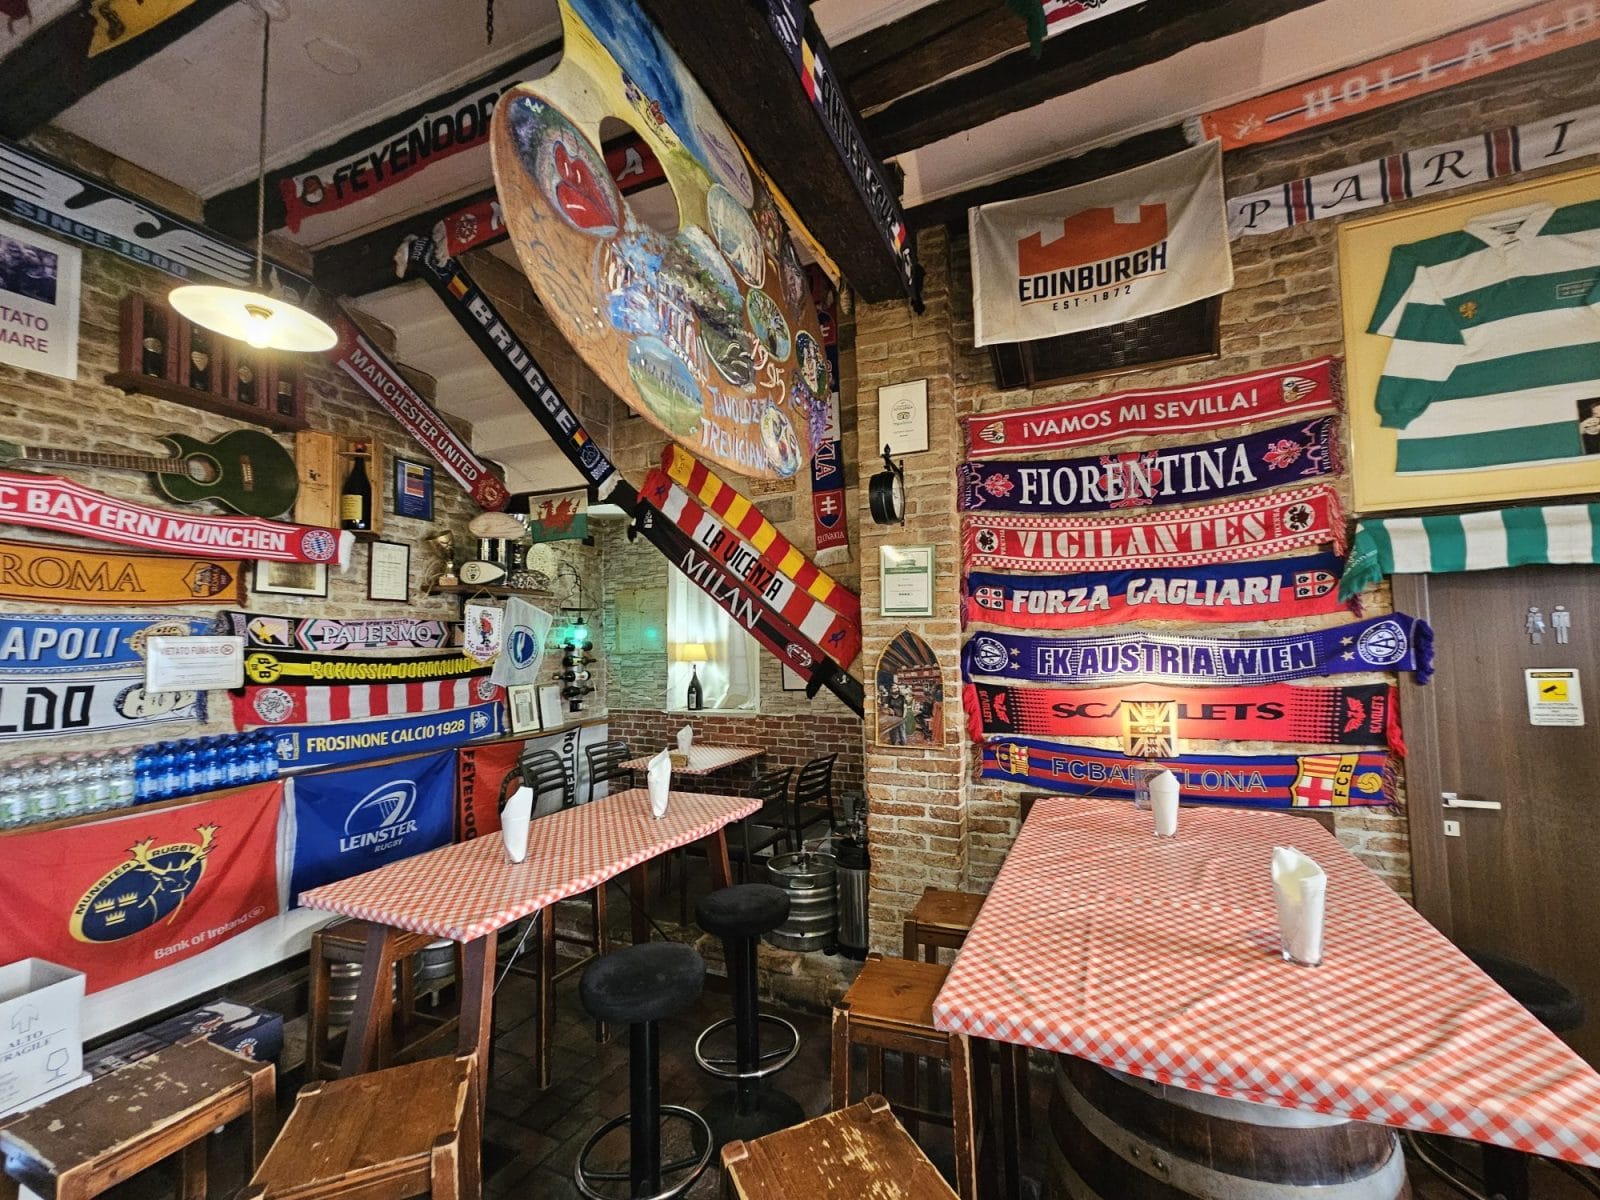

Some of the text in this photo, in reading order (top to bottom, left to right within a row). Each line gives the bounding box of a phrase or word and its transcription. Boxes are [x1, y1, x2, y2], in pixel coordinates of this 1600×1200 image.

[1302, 4, 1595, 119] HOLLAND
[332, 82, 521, 199] FEYENOOR
[1240, 119, 1578, 229] PARI
[13, 201, 112, 247] SINCE
[1018, 241, 1168, 303] EDINBURGH
[468, 296, 576, 434] BRUGGE
[350, 348, 478, 482] MANCHESTER UNITED
[1119, 405, 1147, 423] MI
[1154, 388, 1259, 420] SEVILLA!
[1017, 444, 1258, 505] FIORENTINA
[27, 489, 161, 537] BAYERN
[165, 517, 287, 552] MÜNCHEN
[817, 531, 845, 545] SLOVAKIA
[1015, 511, 1269, 558] VIGILANTES
[1, 556, 147, 592] ROMA
[680, 547, 763, 630] MILAN
[724, 544, 783, 601] VICENZA
[1012, 574, 1281, 615] FORZA CAGLIARI
[1, 627, 121, 661] APOLI
[321, 625, 432, 645] PALERMO
[310, 657, 472, 680] BORUSSIA DORTMUND
[1036, 646, 1074, 676] FK
[1077, 642, 1218, 677] AUSTRIA
[1218, 639, 1319, 677] WIEN
[1052, 701, 1285, 721] SCLETS
[1369, 695, 1385, 734] SCARLETS
[306, 731, 388, 753] FROSINONE
[391, 725, 433, 744] CALCIO
[435, 719, 466, 738] 1928
[1335, 764, 1353, 798] FCB
[339, 819, 418, 853] LEINSTER
[374, 837, 404, 853] RUGBY
[75, 844, 197, 915] MUNSTER RUGBY
[154, 914, 249, 960] Bank of Ireland
